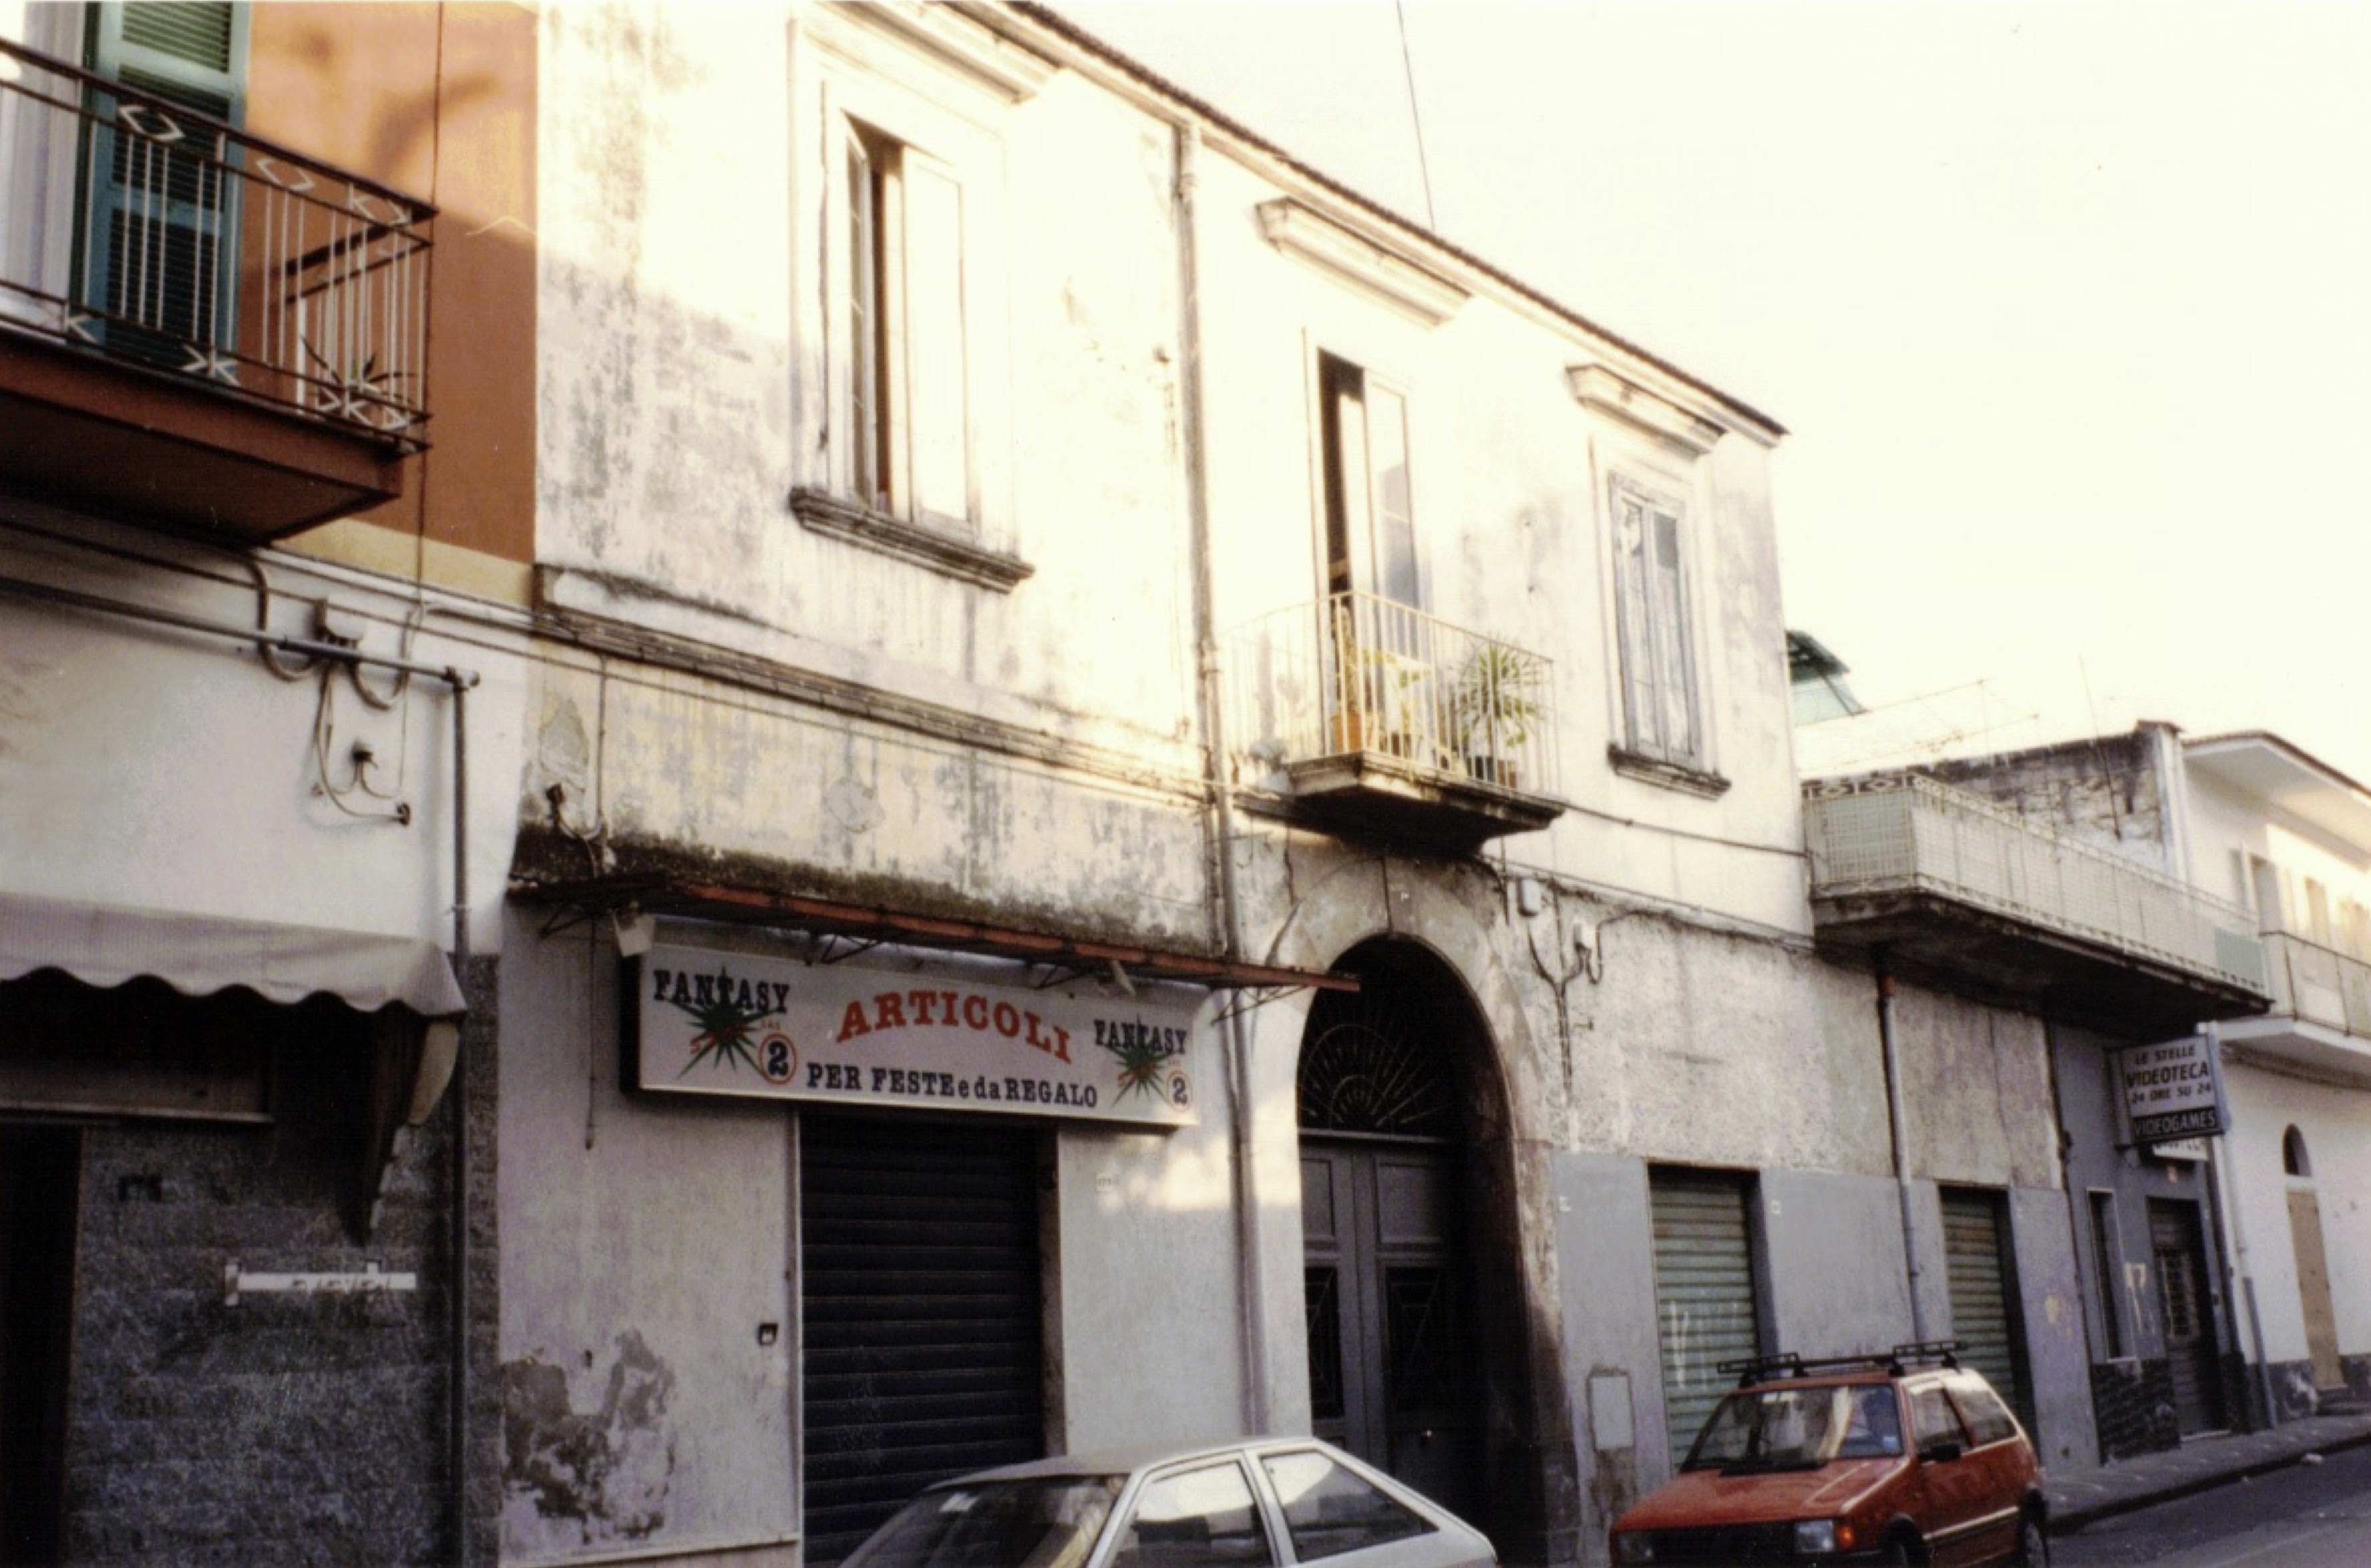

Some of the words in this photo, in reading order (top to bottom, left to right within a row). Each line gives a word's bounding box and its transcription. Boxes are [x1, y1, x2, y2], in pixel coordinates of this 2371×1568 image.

[653, 970, 790, 1014] FANTASY
[836, 990, 1072, 1065] ARTICOLI
[1094, 1020, 1188, 1054] FANTASY
[768, 1040, 789, 1076] 2
[2137, 1052, 2149, 1064] LE
[2155, 1046, 2195, 1060] STELLE
[807, 1062, 862, 1091] PER
[871, 1067, 955, 1097] FESTE
[1004, 1076, 1097, 1109] REGALO
[2127, 1061, 2209, 1088] VIDEOTECA
[1172, 1076, 1188, 1105] 2
[2150, 1089, 2171, 1101] ORE
[2177, 1086, 2191, 1097] SU
[2137, 1110, 2215, 1136] VIDEOGAMES
